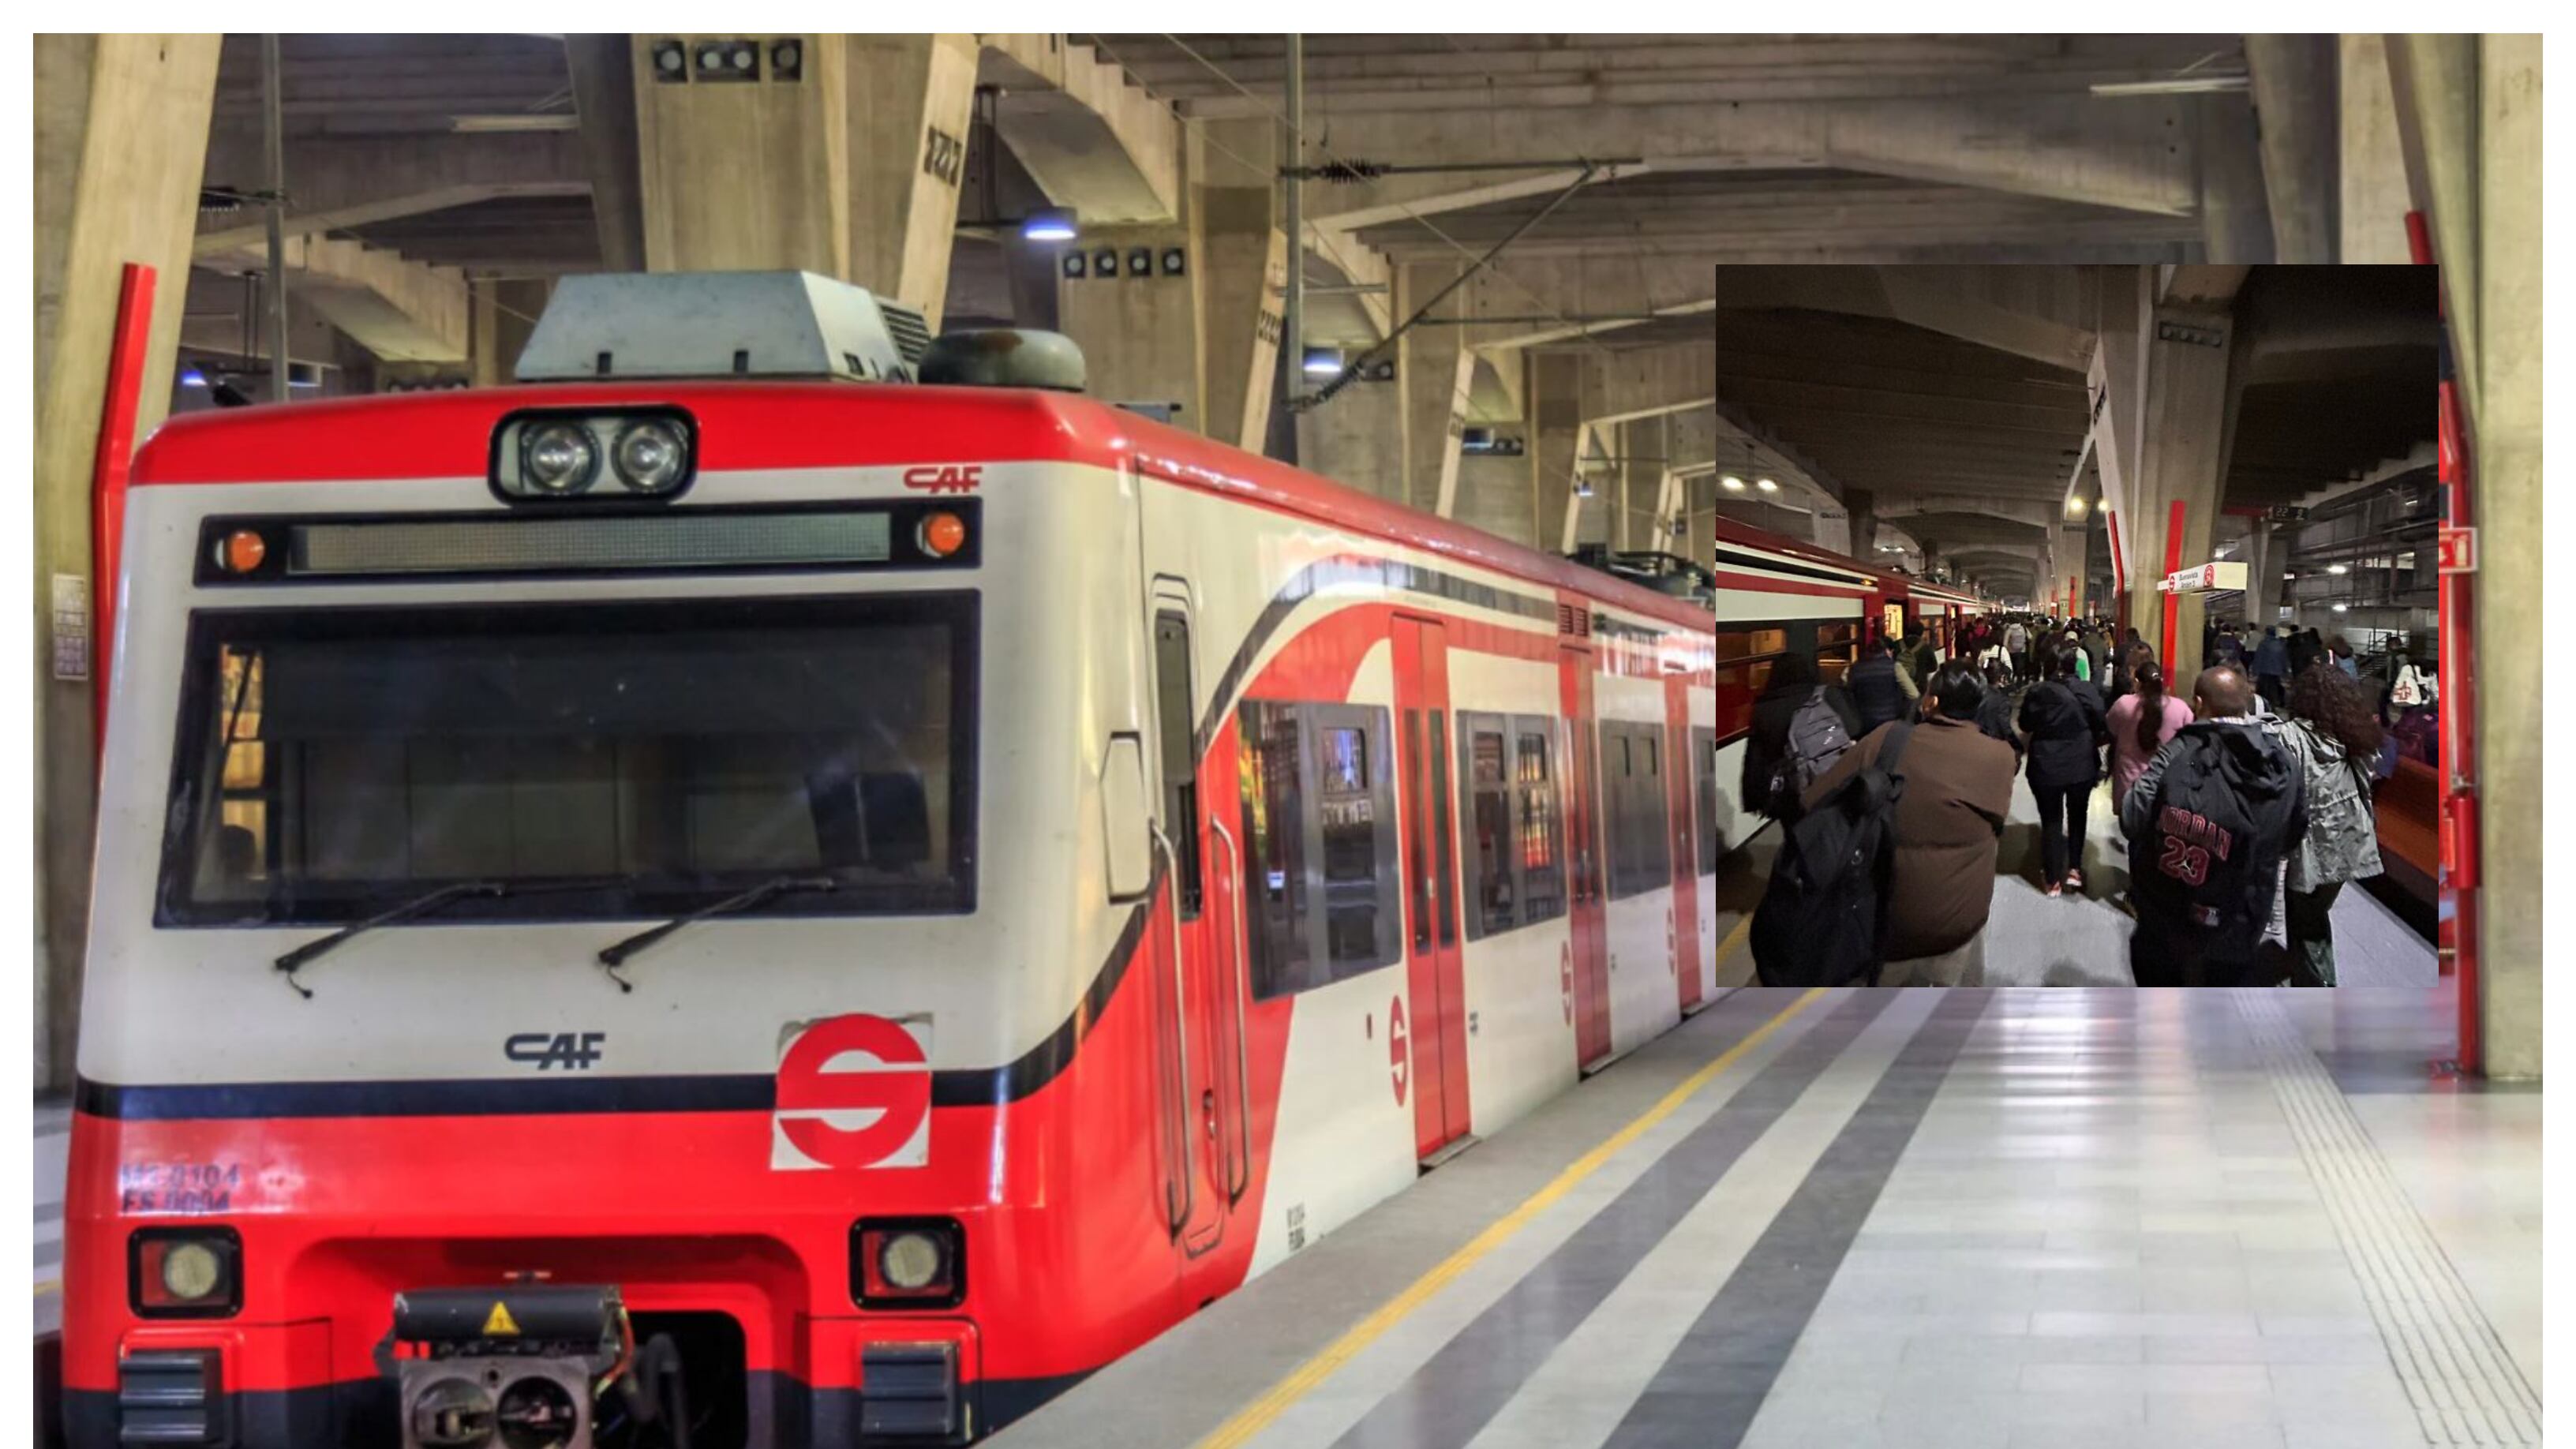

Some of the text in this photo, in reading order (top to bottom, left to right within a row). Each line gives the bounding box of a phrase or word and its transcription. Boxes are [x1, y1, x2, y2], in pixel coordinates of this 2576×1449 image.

[904, 466, 983, 493] CAF
[2159, 805, 2232, 861] JORDAN
[2158, 835, 2211, 886] 23
[505, 1032, 605, 1069] CAF
